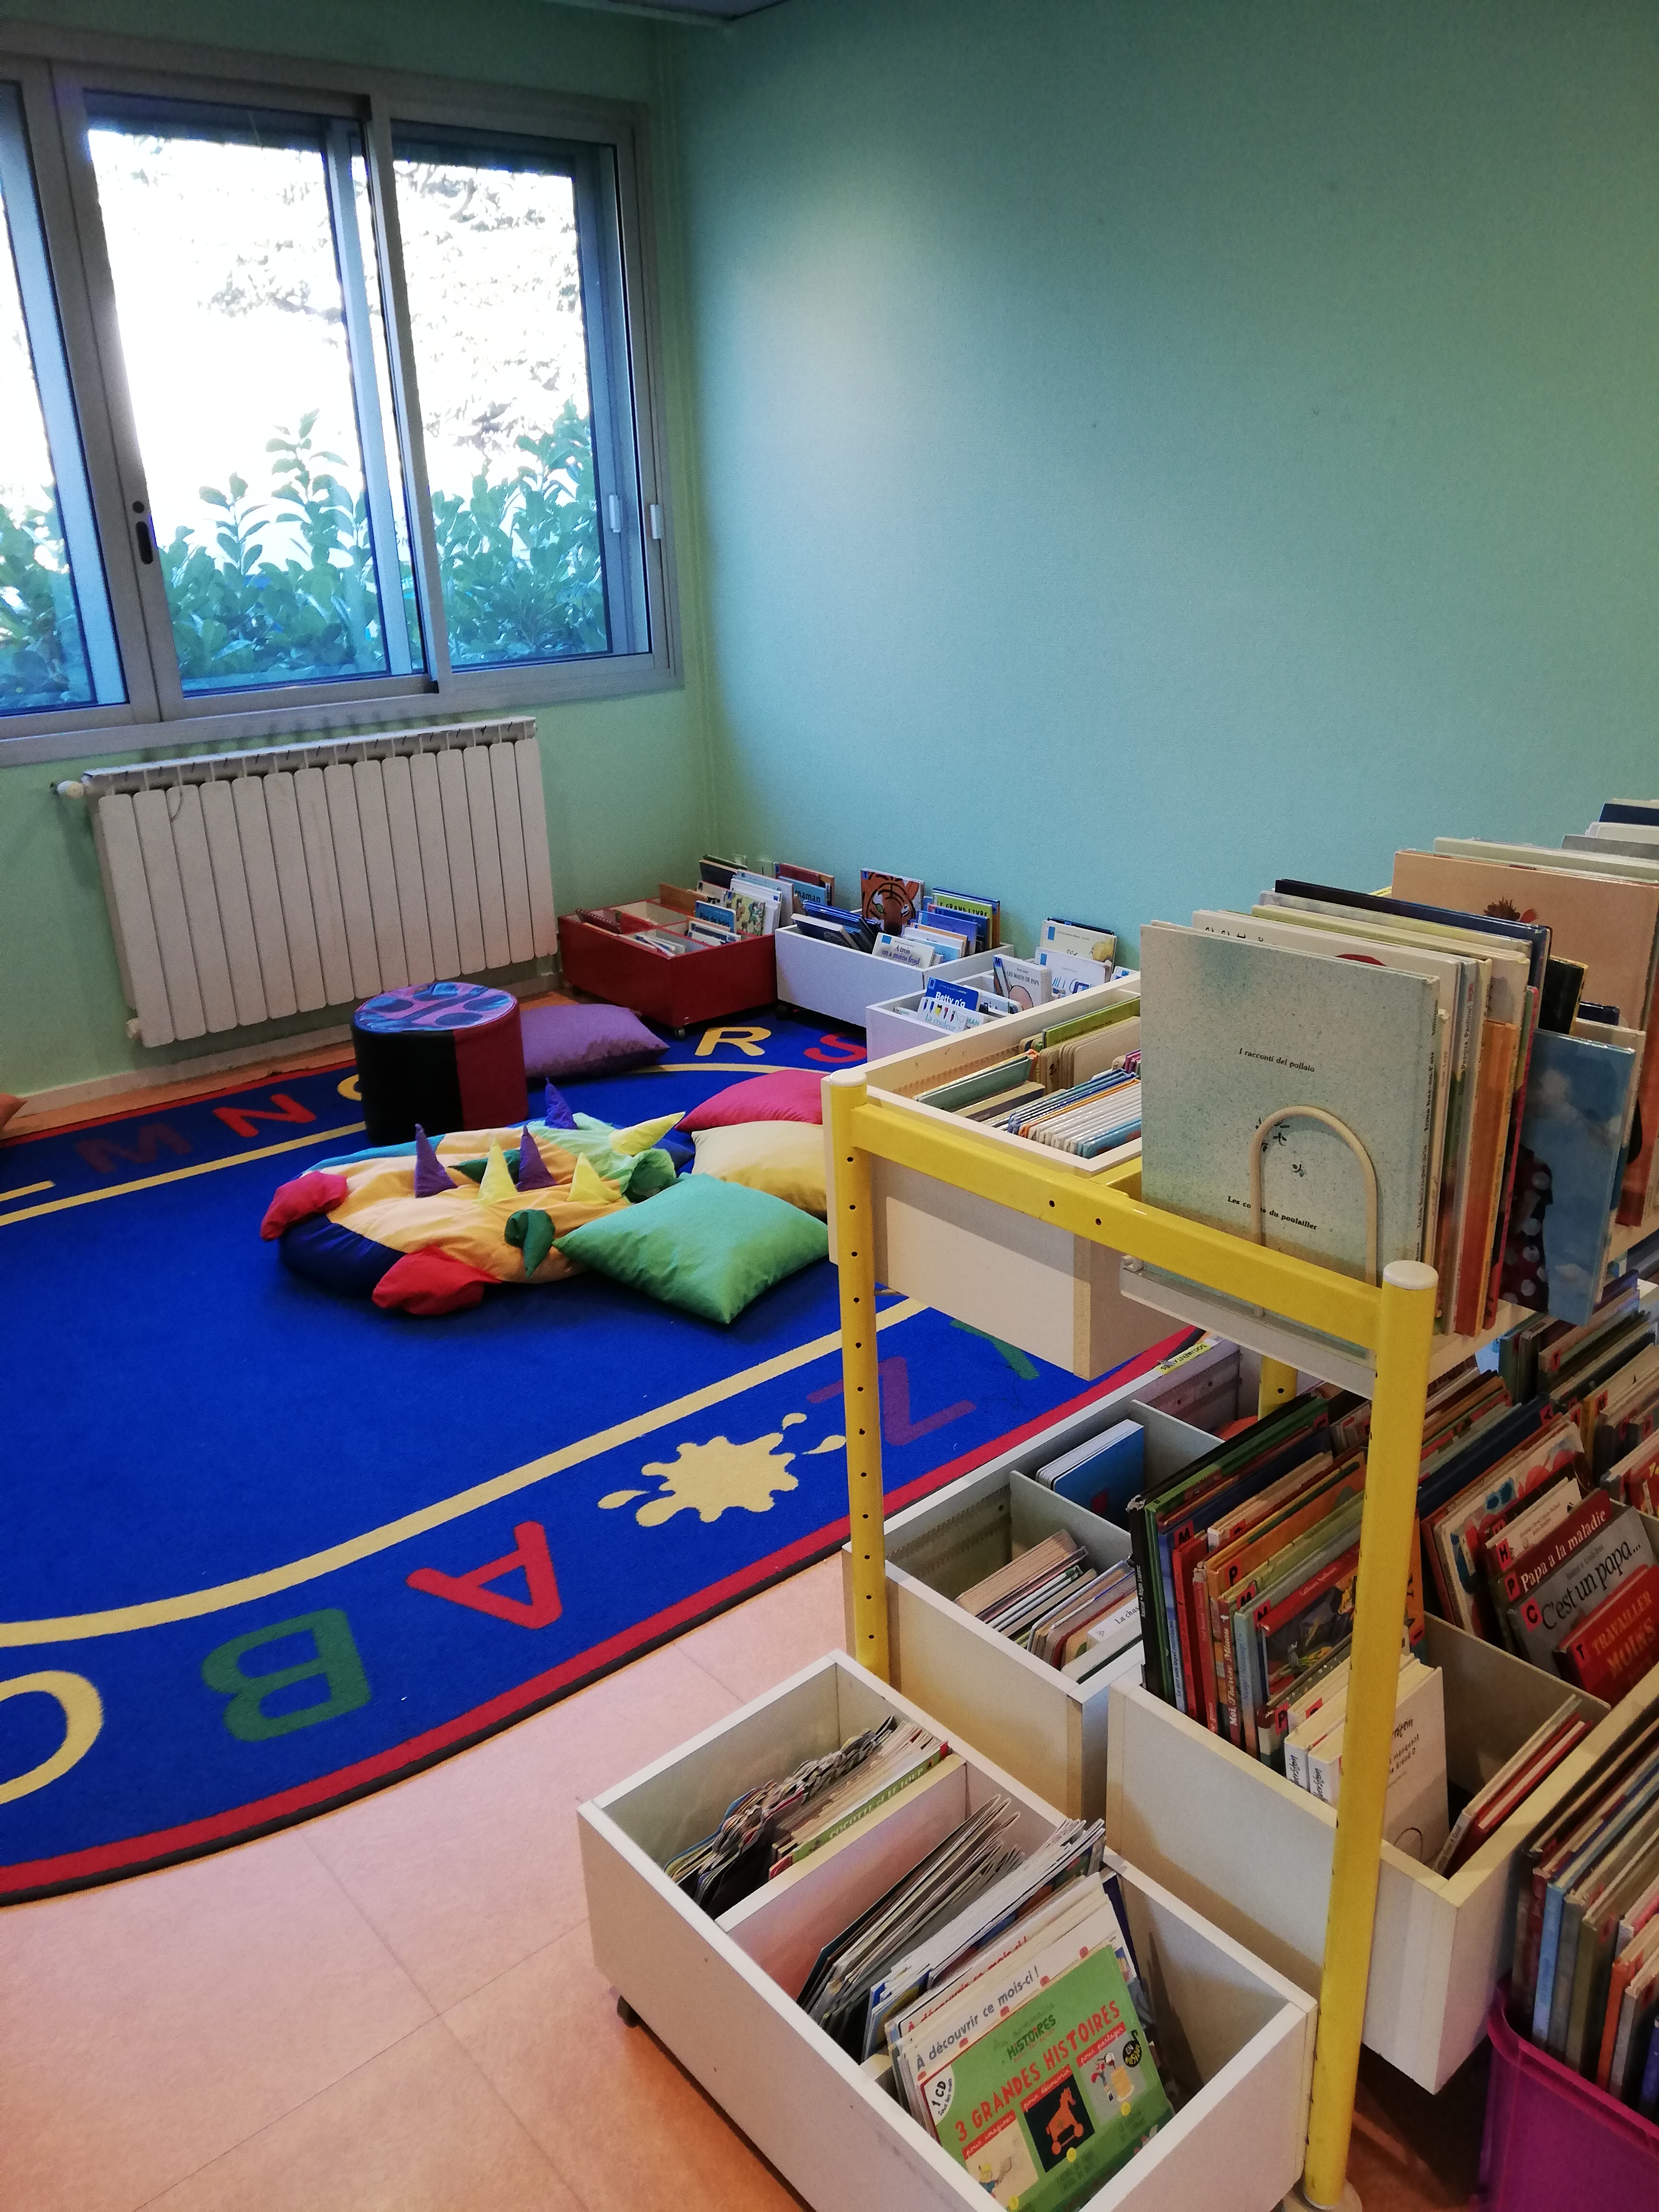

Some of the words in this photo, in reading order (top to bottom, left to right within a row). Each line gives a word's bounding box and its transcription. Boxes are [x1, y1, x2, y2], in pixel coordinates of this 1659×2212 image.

[794, 890, 820, 903] maman
[893, 953, 907, 961] moins
[908, 955, 920, 966] froid
[935, 991, 955, 1004] Betty
[933, 1018, 956, 1033] couleur
[968, 1017, 980, 1027] MAN
[695, 1026, 771, 1057] R
[803, 1033, 866, 1063] S
[1244, 1051, 1275, 1062] racconti
[1276, 1057, 1288, 1066] del
[1289, 1061, 1315, 1072] pollaio
[76, 1122, 192, 1173] M
[213, 1093, 316, 1137] N
[1227, 1195, 1240, 1205] Les
[1242, 1201, 1266, 1214] cos
[1269, 1209, 1279, 1218] du
[1281, 1214, 1318, 1231] poulailler
[1160, 1344, 1208, 1370] DOCUMENTAES
[806, 1355, 977, 1446] Z
[1178, 1527, 1190, 1546] M
[1499, 1545, 1509, 1564] H
[1520, 1560, 1548, 1594] Papa
[1548, 1555, 1556, 1568] a
[1555, 1543, 1567, 1562] la
[1567, 1509, 1607, 1551] maladie
[407, 1521, 563, 1629] A
[1228, 1565, 1238, 1587] P
[1540, 1587, 1578, 1631] C'est
[1575, 1572, 1599, 1603] un
[1593, 1540, 1642, 1591] papa...
[1506, 1578, 1516, 1596] P
[1114, 1616, 1126, 1624] La
[1125, 1606, 1140, 1618] chas
[1526, 1604, 1539, 1624] C
[1591, 1589, 1653, 1656] TRAVAILLER
[1575, 1643, 1585, 1660] T
[1606, 1617, 1658, 1679] MOINS
[201, 1608, 371, 1743] B
[1228, 1707, 1238, 1727] Moi,
[1277, 1709, 1287, 1729] P
[916, 2054, 926, 2072] À
[928, 2014, 979, 2061] découvrir
[982, 2003, 995, 2017] ce
[997, 1970, 1034, 2007] mois-ci
[1080, 2048, 1095, 2066] pour
[1097, 2025, 1125, 2052] partager
[1124, 2043, 1135, 2055] EN
[954, 2120, 968, 2142] 3
[971, 2062, 1041, 2129] GRANDES
[1043, 2000, 1120, 2071] HISTOIRES
[935, 2080, 946, 2097] CD
[1022, 2095, 1039, 2113] pour
[1040, 2068, 1071, 2095] découvrir
[965, 2141, 983, 2160] pour
[984, 2114, 1014, 2141] imaginer
